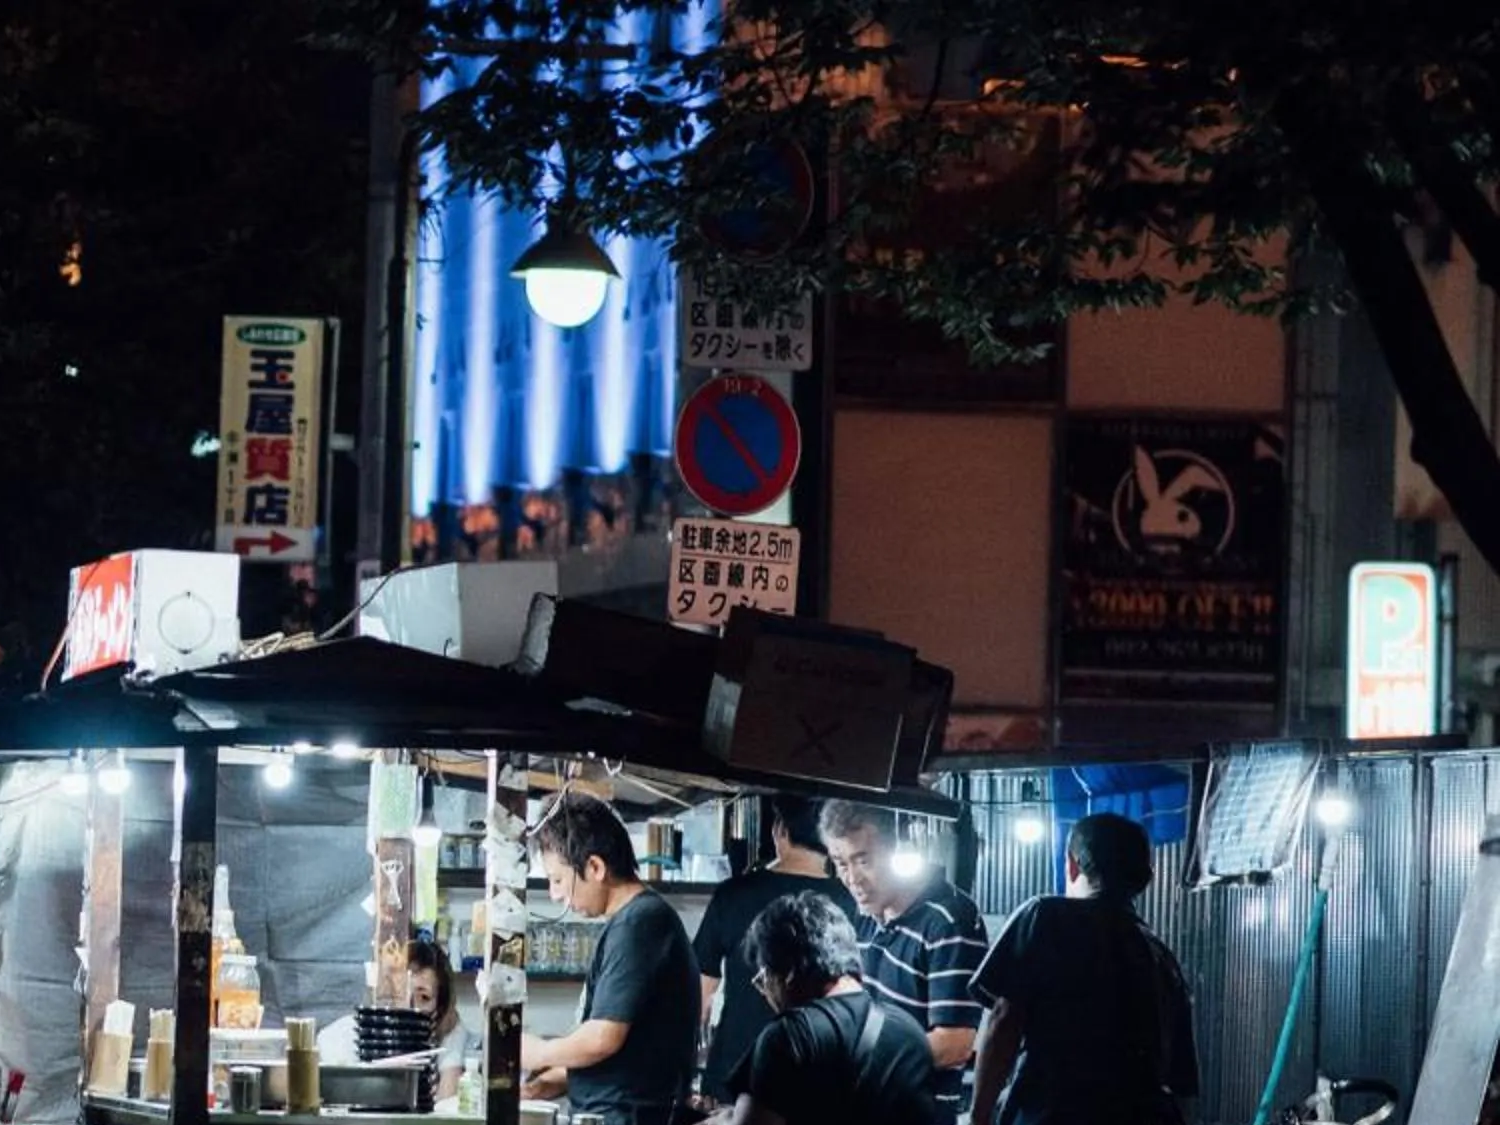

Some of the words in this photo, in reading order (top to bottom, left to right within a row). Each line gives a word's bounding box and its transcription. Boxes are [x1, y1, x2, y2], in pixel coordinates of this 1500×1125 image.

[690, 332, 805, 362] タクシーを除く
[244, 350, 296, 526] 玉屋質店
[681, 523, 794, 562] 駐車余地2.5m
